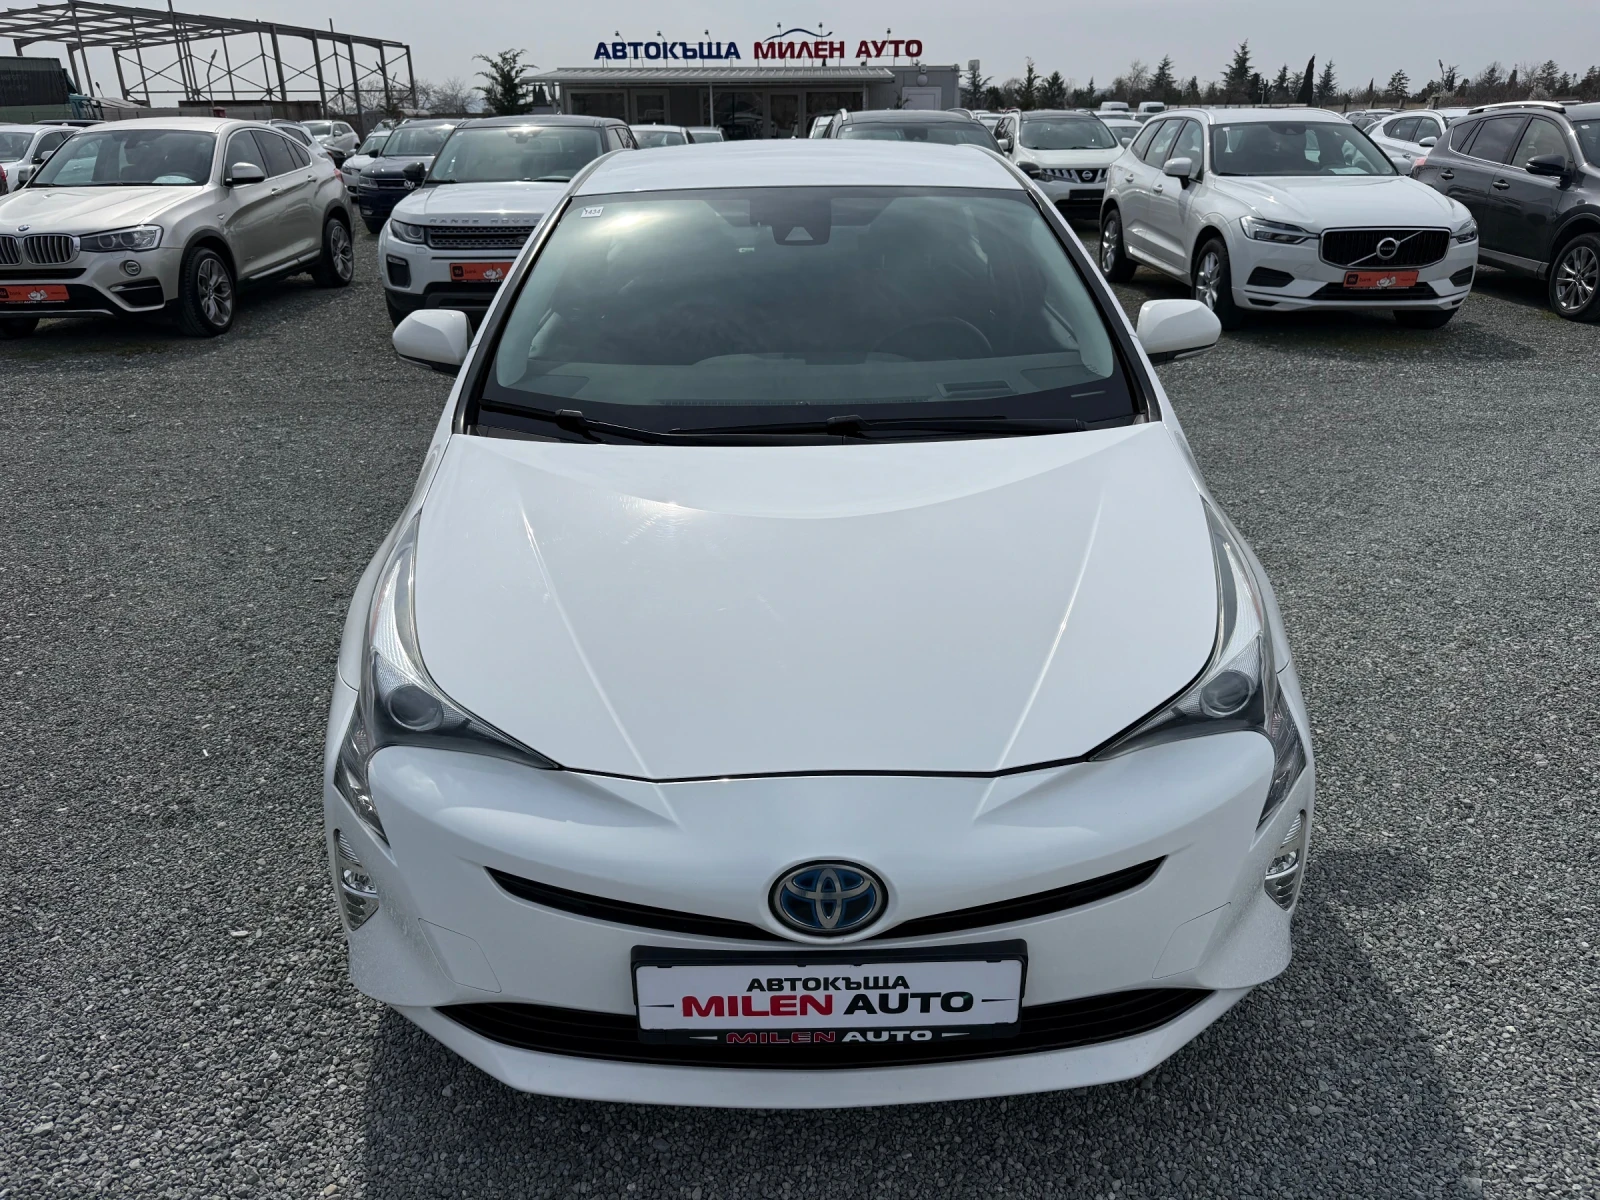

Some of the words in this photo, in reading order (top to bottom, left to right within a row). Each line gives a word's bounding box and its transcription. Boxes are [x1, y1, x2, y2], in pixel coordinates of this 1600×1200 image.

[594, 41, 741, 60] АВТОКЪЩА
[753, 40, 846, 59] МИЛЕН
[855, 39, 924, 58] АУТО
[746, 976, 910, 992] АВТОКЪЩА
[682, 995, 833, 1017] MILEN
[843, 991, 974, 1015] AUTO
[726, 1031, 836, 1044] MILEN
[842, 1030, 933, 1043] AUTO
